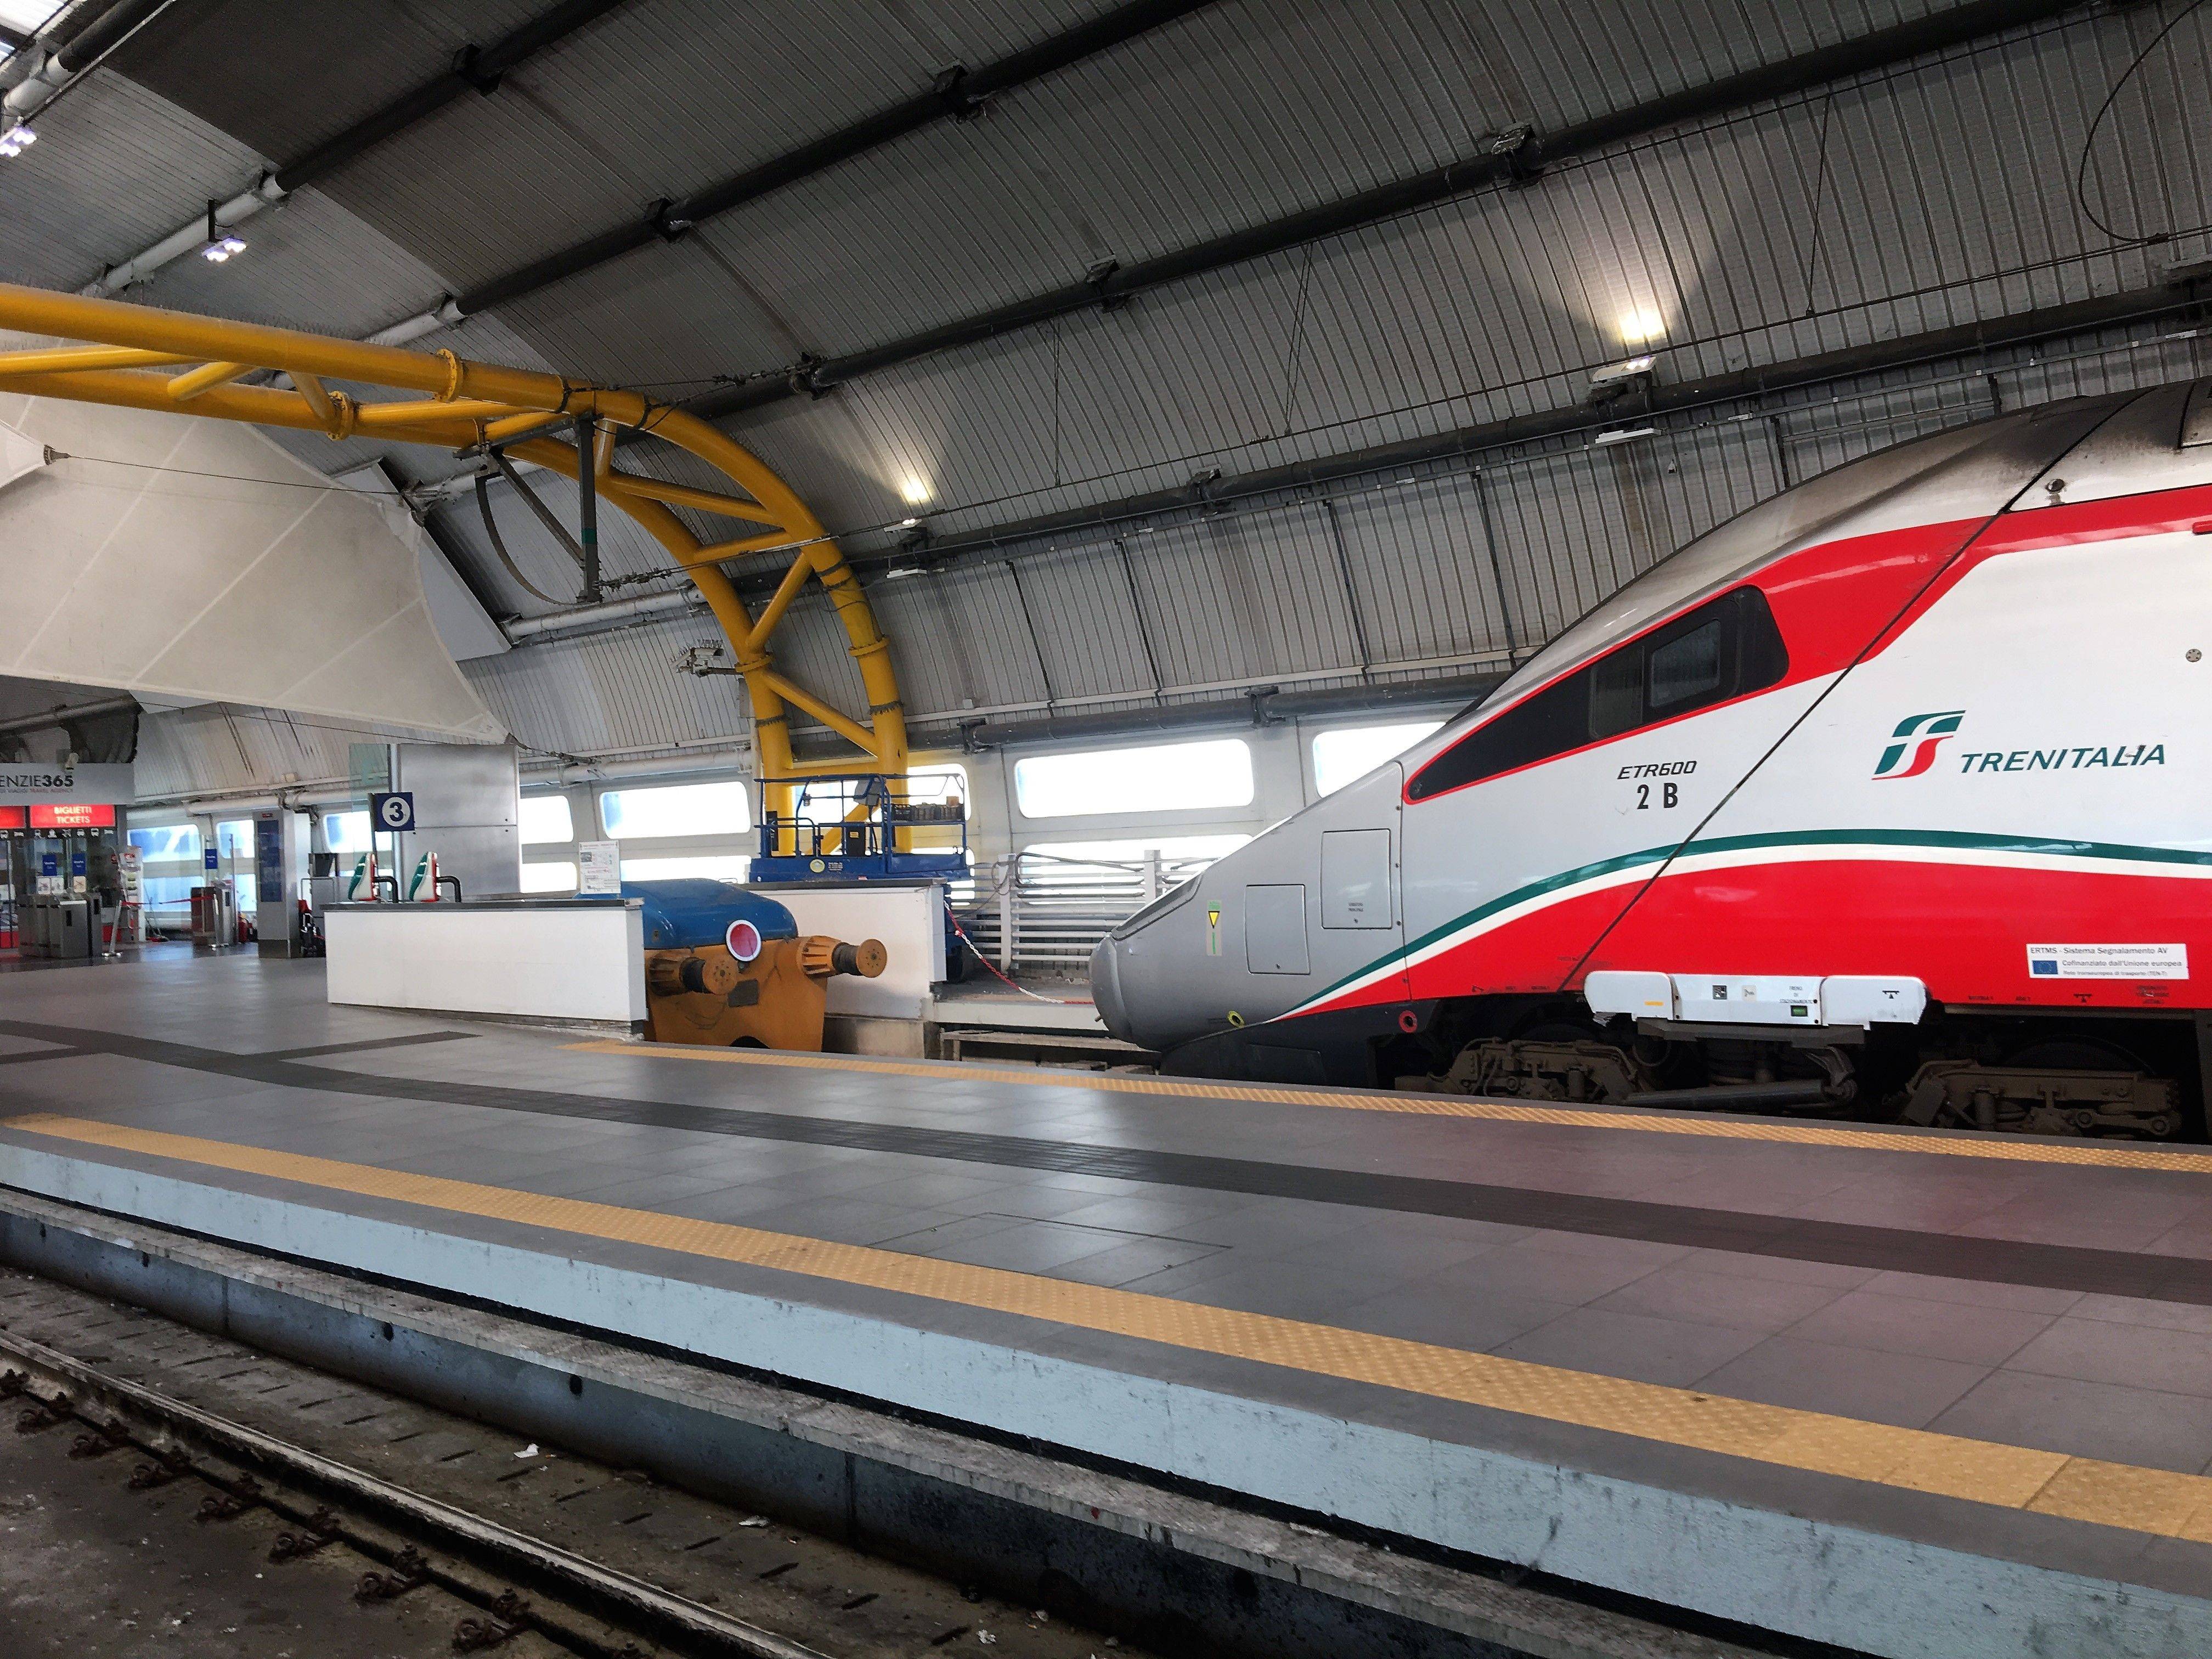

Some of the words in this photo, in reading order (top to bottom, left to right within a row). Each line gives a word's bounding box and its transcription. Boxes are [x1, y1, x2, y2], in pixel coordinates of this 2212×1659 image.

[1961, 744, 2165, 774] TRENITALIA
[1616, 760, 1697, 780] ETR600
[1637, 784, 1650, 810] 2
[1663, 782, 1679, 809] B
[54, 806, 92, 815] BIGLIETTI
[389, 802, 404, 822] 3
[2097, 947, 2155, 955] Segnalamento
